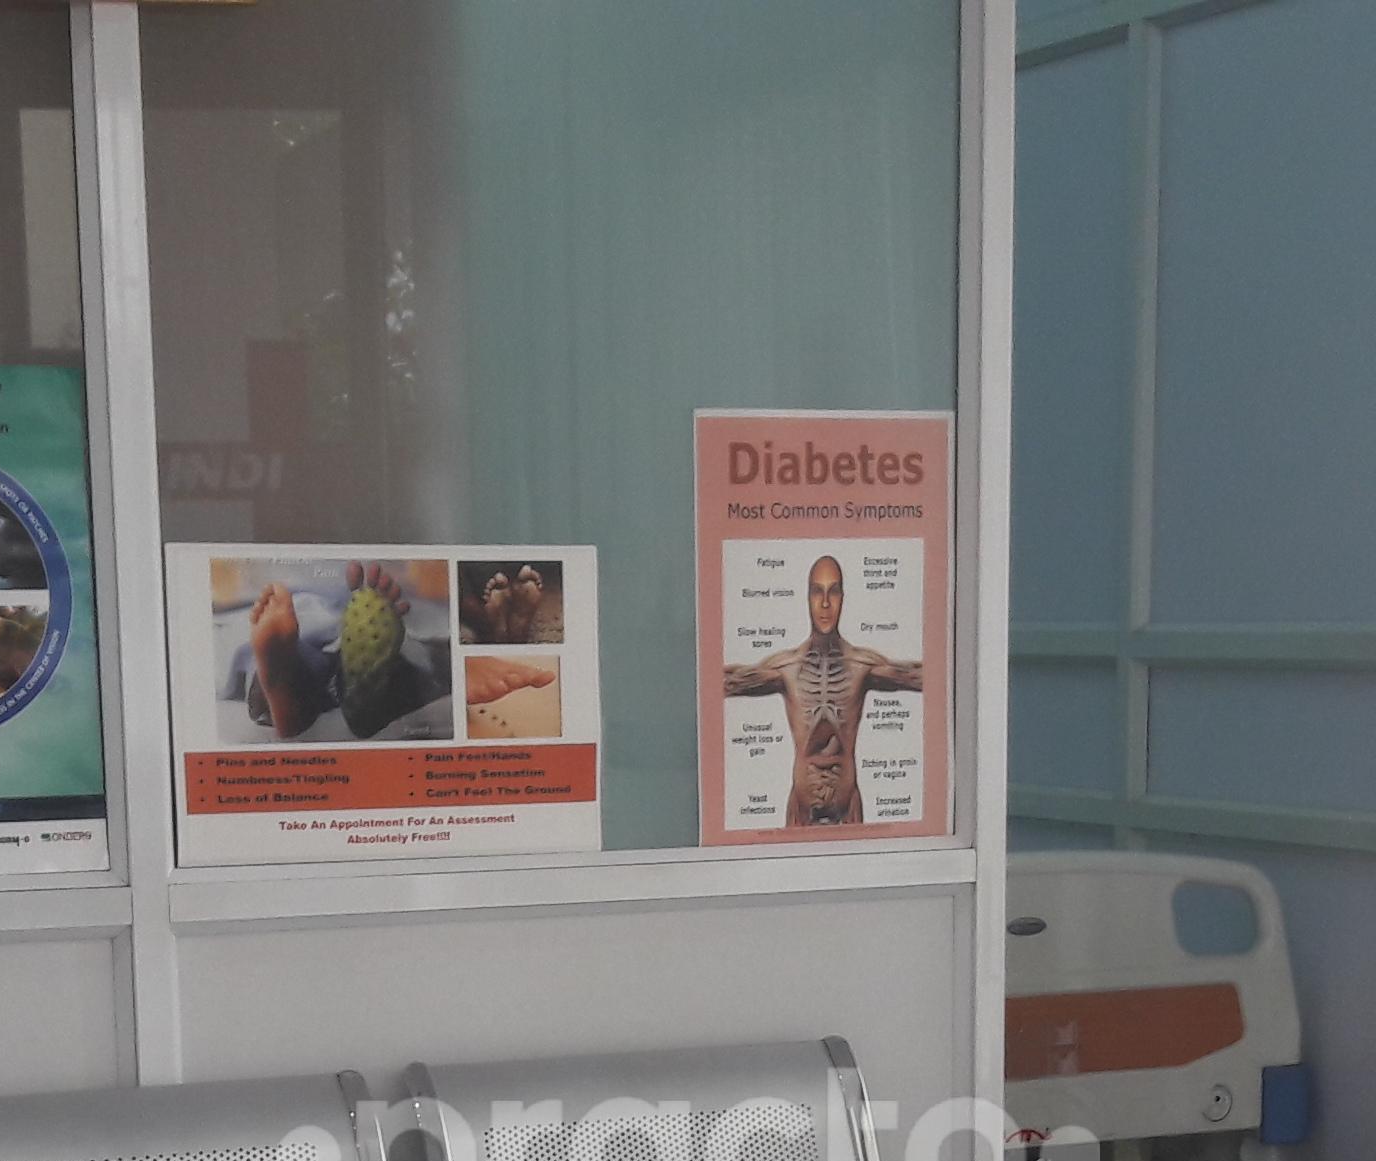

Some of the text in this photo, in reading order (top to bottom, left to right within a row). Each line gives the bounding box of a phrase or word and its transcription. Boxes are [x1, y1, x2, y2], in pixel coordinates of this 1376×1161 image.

[728, 440, 925, 487] Diabetes
[727, 500, 924, 522] Most Common Symptoms
[250, 756, 276, 767] and
[425, 752, 454, 763] Pain
[425, 768, 546, 781] Burning Sensation
[497, 786, 521, 795] The
[524, 784, 572, 795] Ground
[272, 791, 330, 803] Balance
[279, 813, 516, 832] Take An Appointment For An Assessment
[347, 832, 409, 845] Absolutely
